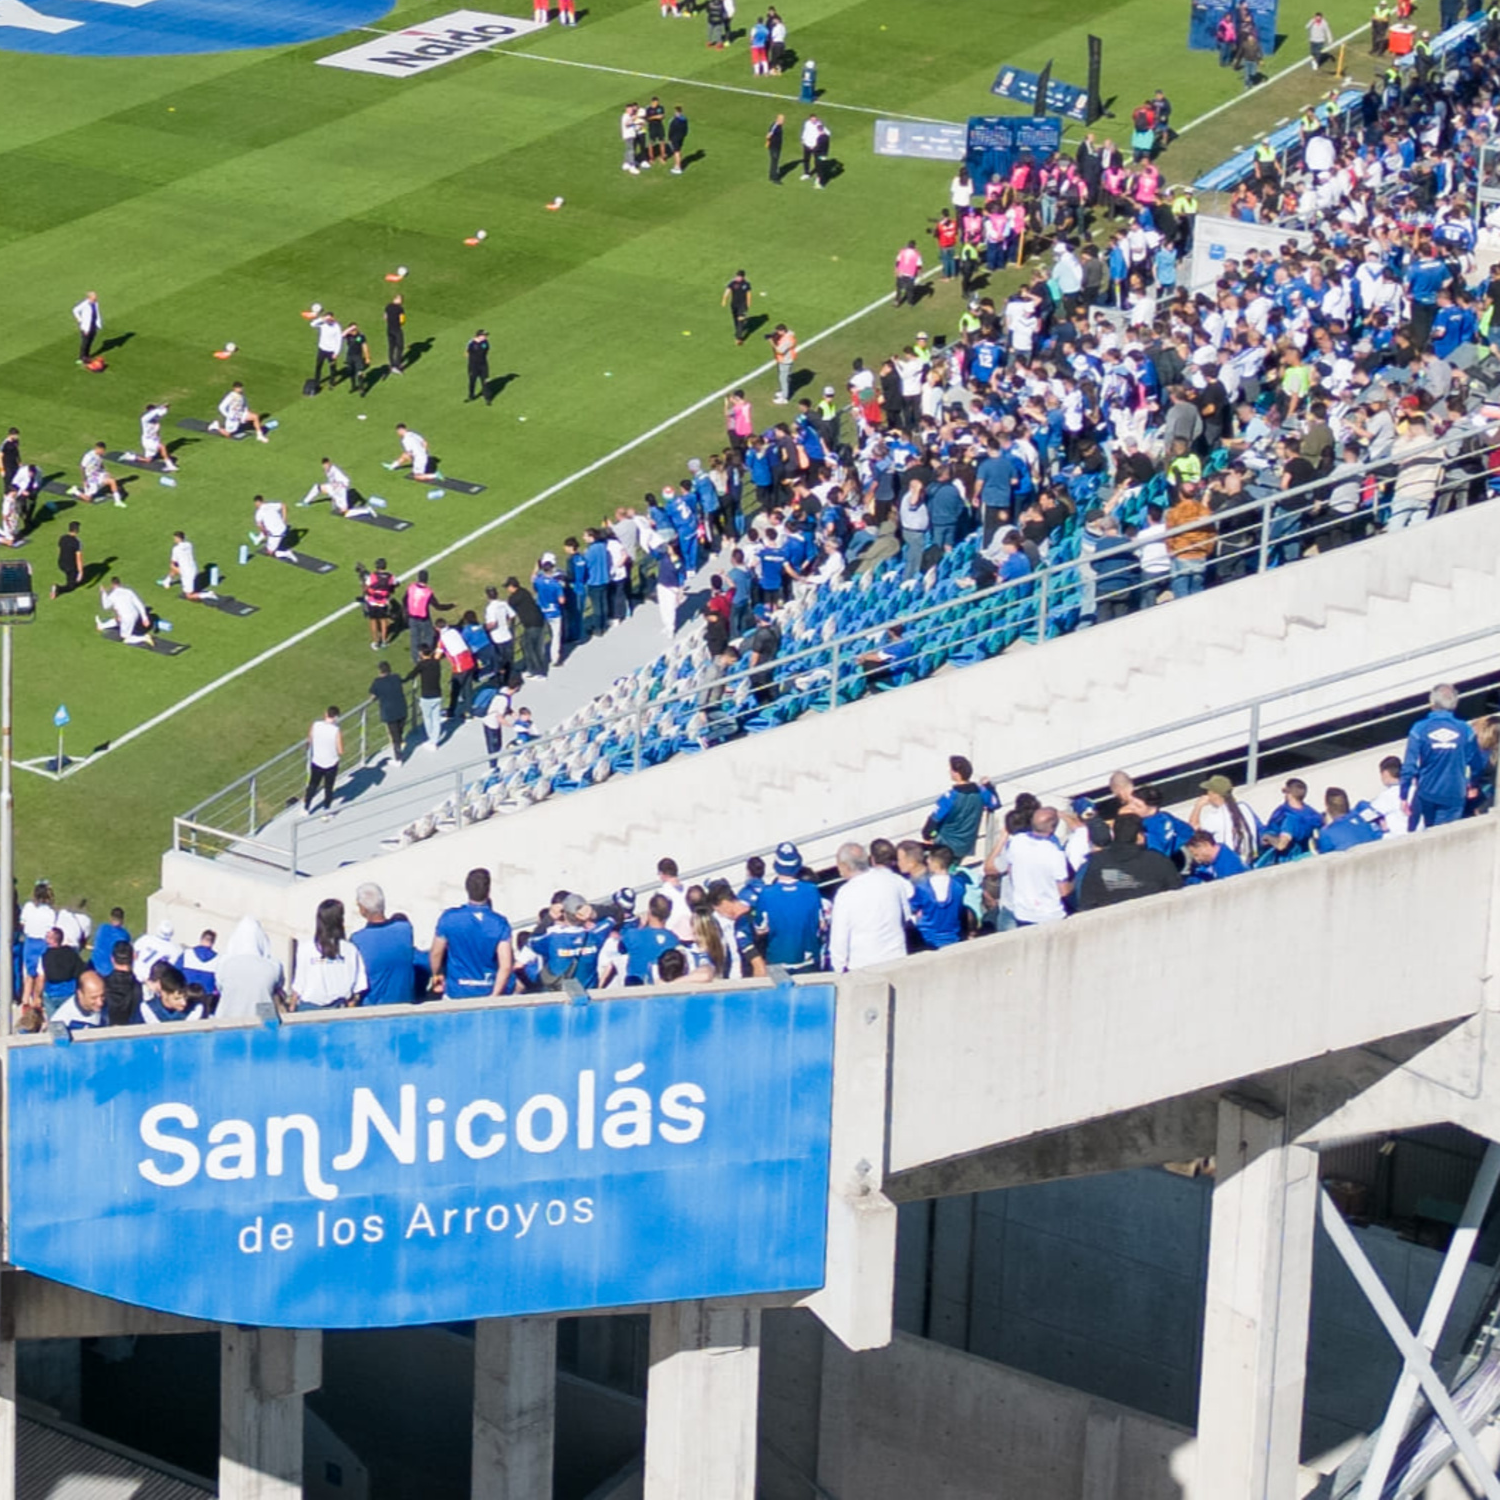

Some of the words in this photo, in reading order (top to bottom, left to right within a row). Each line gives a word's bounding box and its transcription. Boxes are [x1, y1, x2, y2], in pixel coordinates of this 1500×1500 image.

[367, 25, 516, 68] Naldo
[138, 1102, 339, 1201] San
[332, 1062, 706, 1172] Nicolás
[239, 1216, 293, 1253] de
[317, 1211, 384, 1247] los
[405, 1197, 594, 1239] Arroyos
